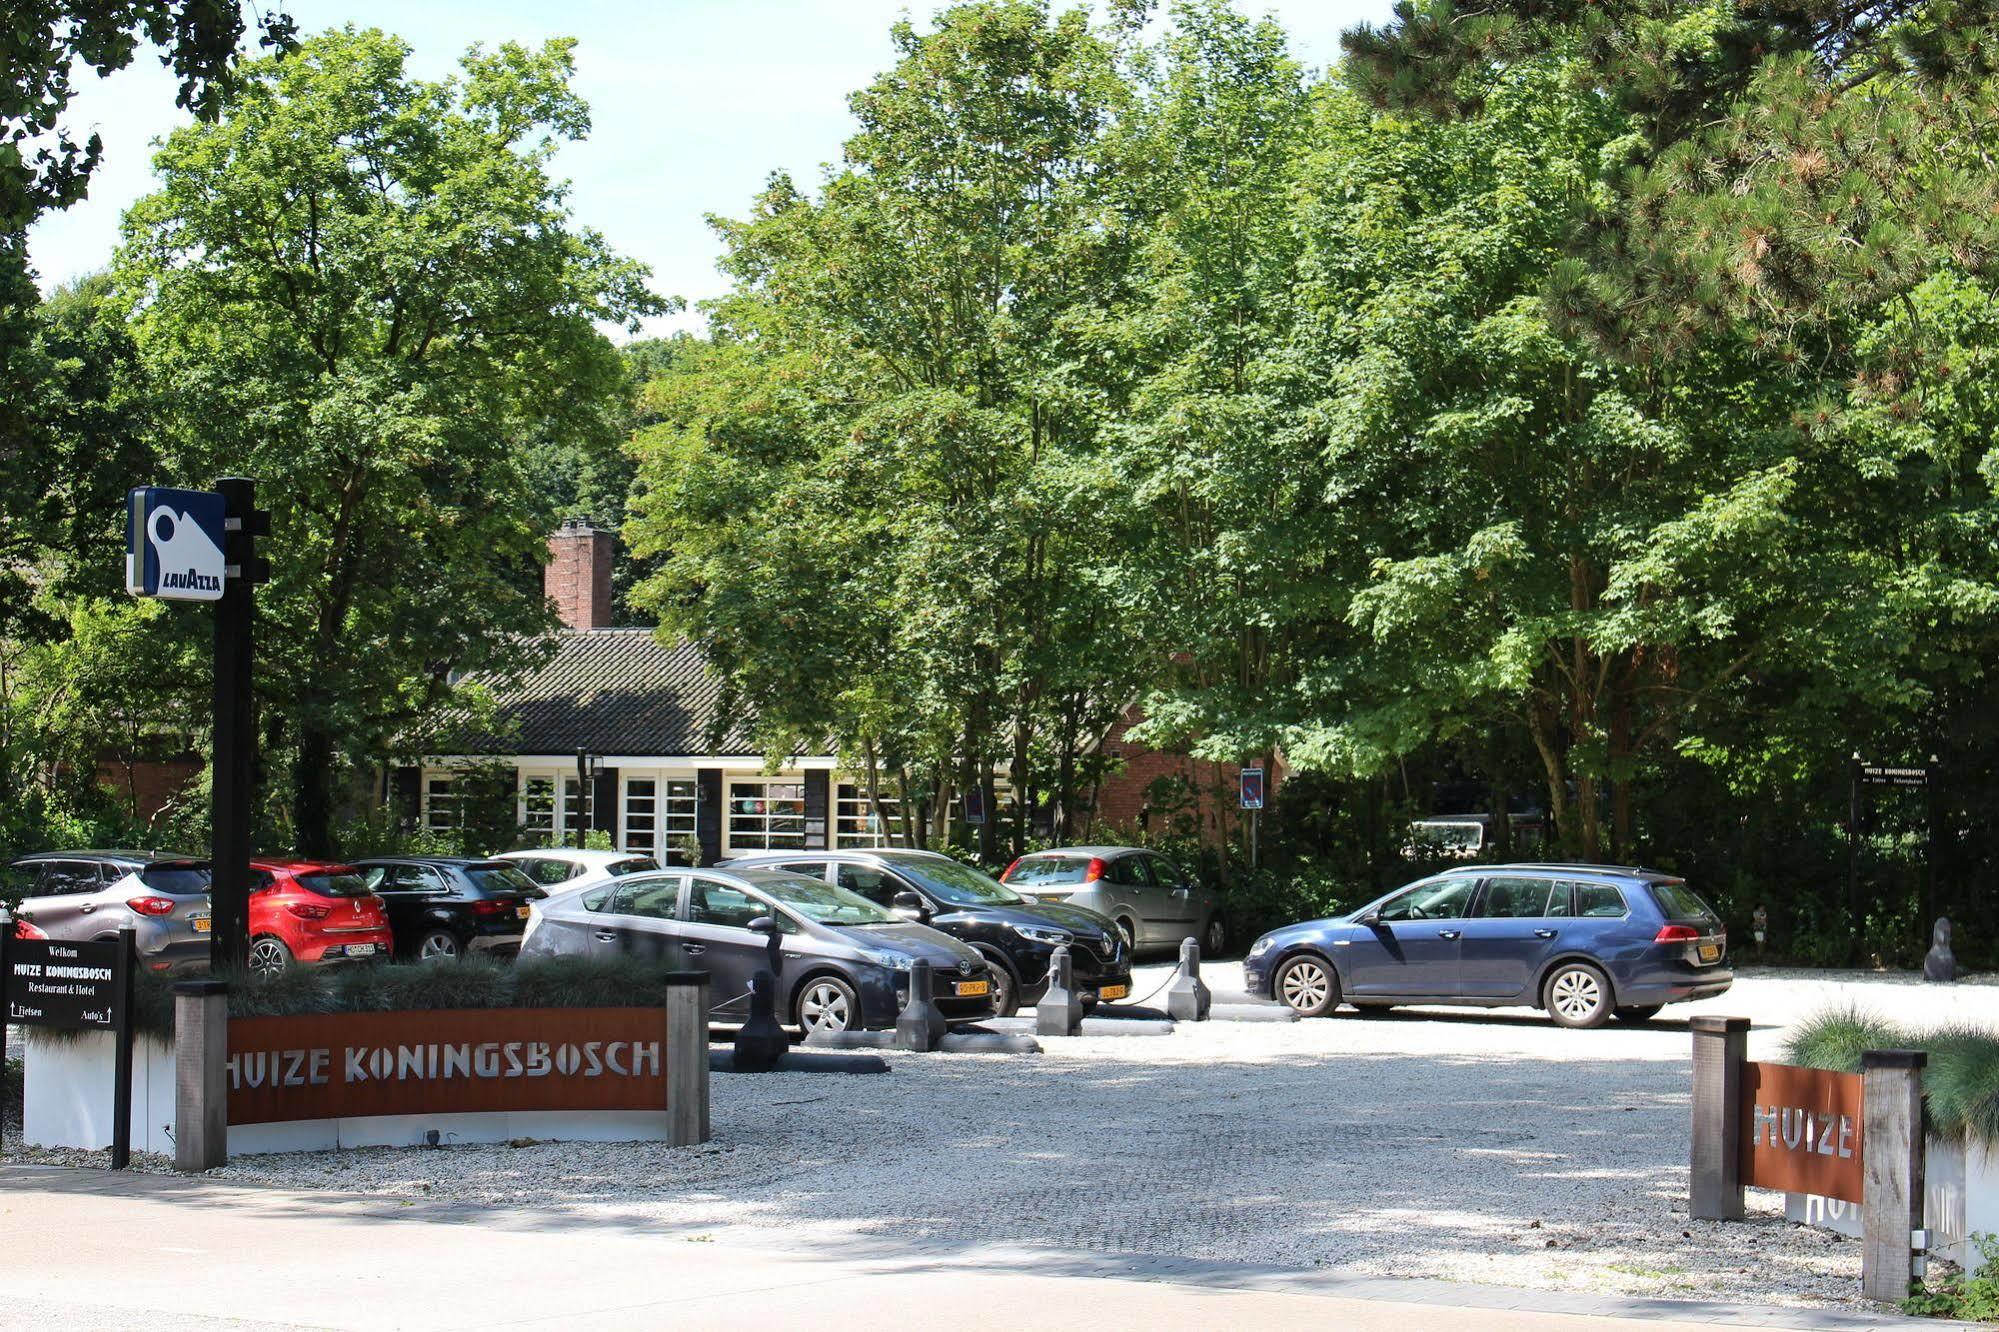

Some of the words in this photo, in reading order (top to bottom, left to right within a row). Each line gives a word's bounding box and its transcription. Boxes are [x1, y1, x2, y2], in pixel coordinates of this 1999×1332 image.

[163, 568, 221, 591] LAVAZZA
[48, 945, 78, 958] Welkom
[13, 963, 42, 976] HUIZE
[45, 965, 112, 980] KONINGSBOSCH
[28, 981, 67, 995] Restaurant
[68, 984, 74, 995] &
[75, 985, 95, 996] Hotel
[18, 1005, 42, 1017] Fietsen
[81, 1010, 103, 1021] Auto's
[345, 1042, 660, 1083] KONINGSBOSCH
[1753, 1104, 1853, 1159] HUIZE
